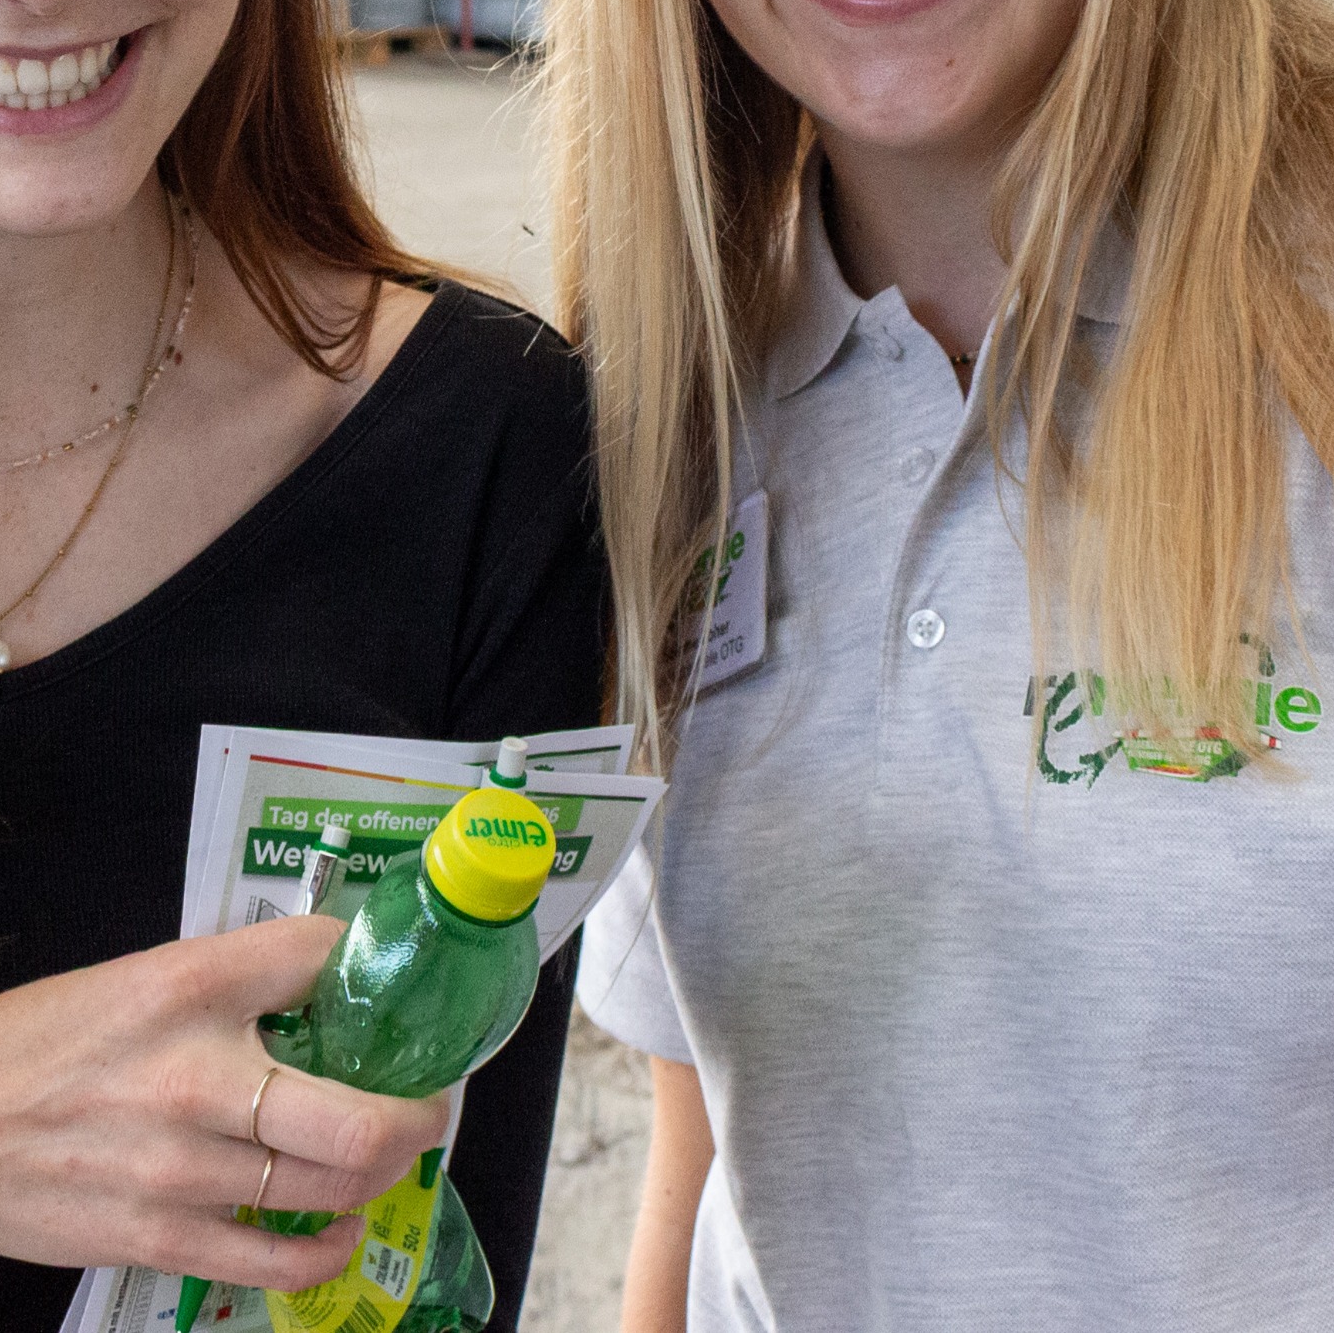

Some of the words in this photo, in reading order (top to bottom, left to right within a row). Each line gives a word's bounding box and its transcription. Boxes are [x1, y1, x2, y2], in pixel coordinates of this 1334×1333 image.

[720, 634, 744, 661] OTG
[269, 806, 309, 831] Tag
[315, 807, 354, 829] der
[358, 810, 440, 832] offenen
[487, 837, 521, 849] citro
